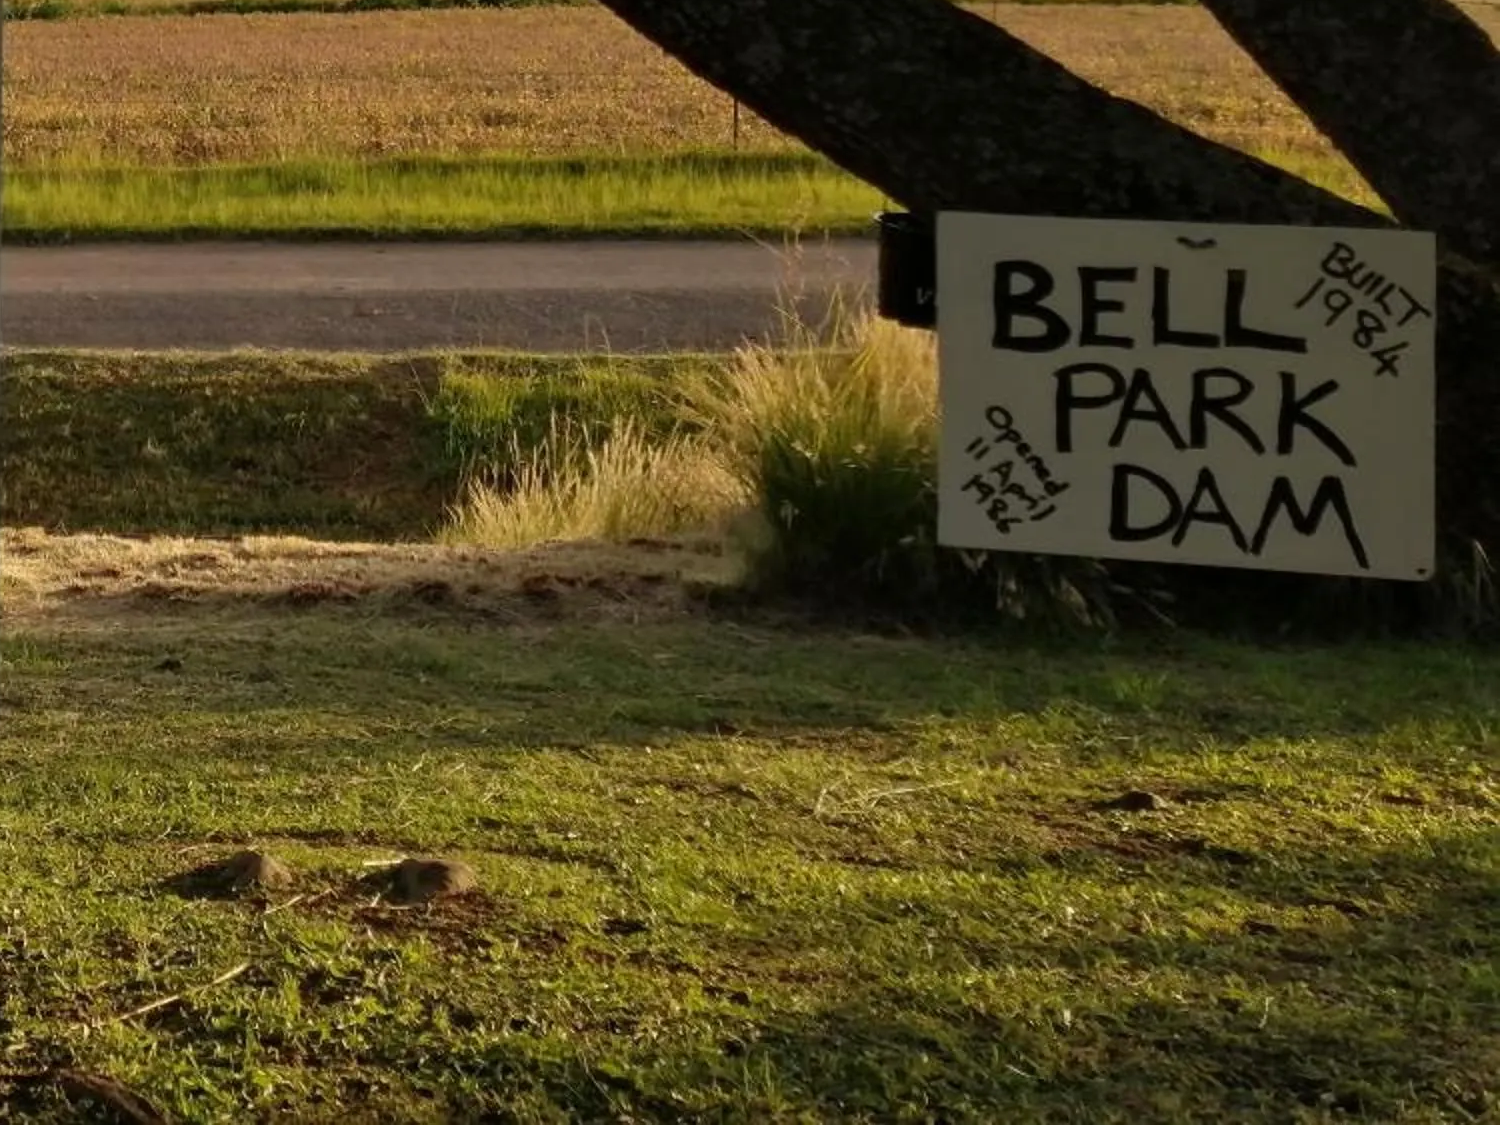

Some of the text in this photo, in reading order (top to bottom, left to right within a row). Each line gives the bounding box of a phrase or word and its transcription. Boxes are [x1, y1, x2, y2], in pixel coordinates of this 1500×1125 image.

[992, 260, 1307, 353] BELL
[1294, 277, 1409, 377] 1984
[1321, 241, 1432, 327] BUILT
[984, 405, 1070, 497] Opened
[1054, 362, 1357, 467] PARK
[1108, 463, 1369, 570] DAM
